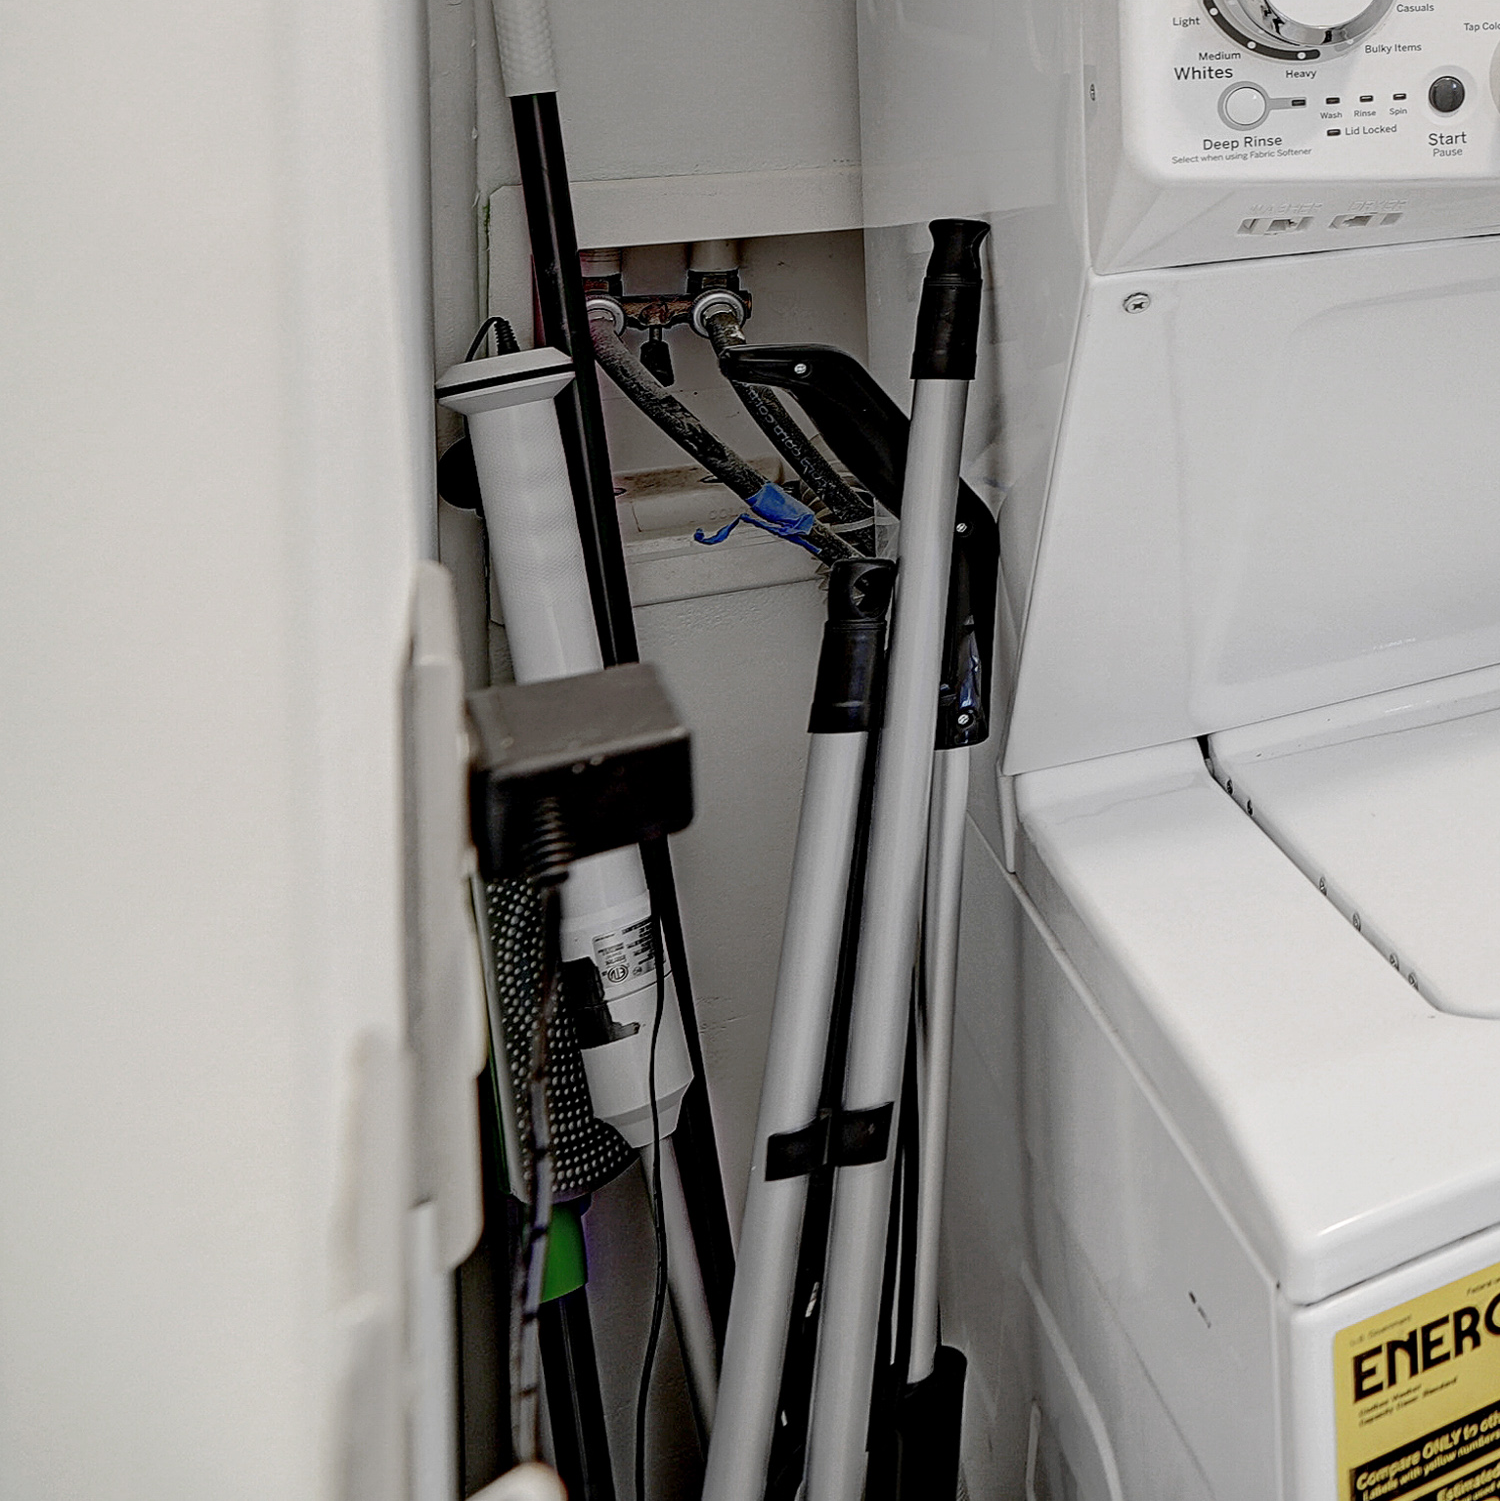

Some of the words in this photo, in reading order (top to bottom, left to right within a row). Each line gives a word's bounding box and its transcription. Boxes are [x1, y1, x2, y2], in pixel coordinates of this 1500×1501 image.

[1396, 3, 1435, 13] Casuals
[1172, 17, 1200, 27] Light
[1464, 23, 1480, 32] Tap
[1364, 43, 1391, 55] Bulky
[1394, 43, 1422, 53] Items
[1198, 51, 1241, 61] Medium
[1174, 66, 1233, 81] Whites
[1285, 69, 1317, 80] Heavy
[1320, 111, 1343, 119] Wash
[1353, 108, 1377, 117] Rinse
[1389, 107, 1407, 116] Spin
[1345, 126, 1360, 136] Lid
[1362, 124, 1397, 135] Locked
[1203, 139, 1239, 151] Deep
[1244, 136, 1282, 147] Rinse
[1428, 132, 1467, 146] Start
[1172, 156, 1199, 164] Select
[1201, 153, 1223, 162] when
[1226, 152, 1248, 160] using
[1250, 150, 1275, 158] Fabric
[1277, 148, 1312, 156] Softener
[1433, 147, 1463, 157] Pause
[1357, 1451, 1420, 1490] Compare
[1422, 1428, 1461, 1459] ONLY
[1463, 1424, 1478, 1440] to
